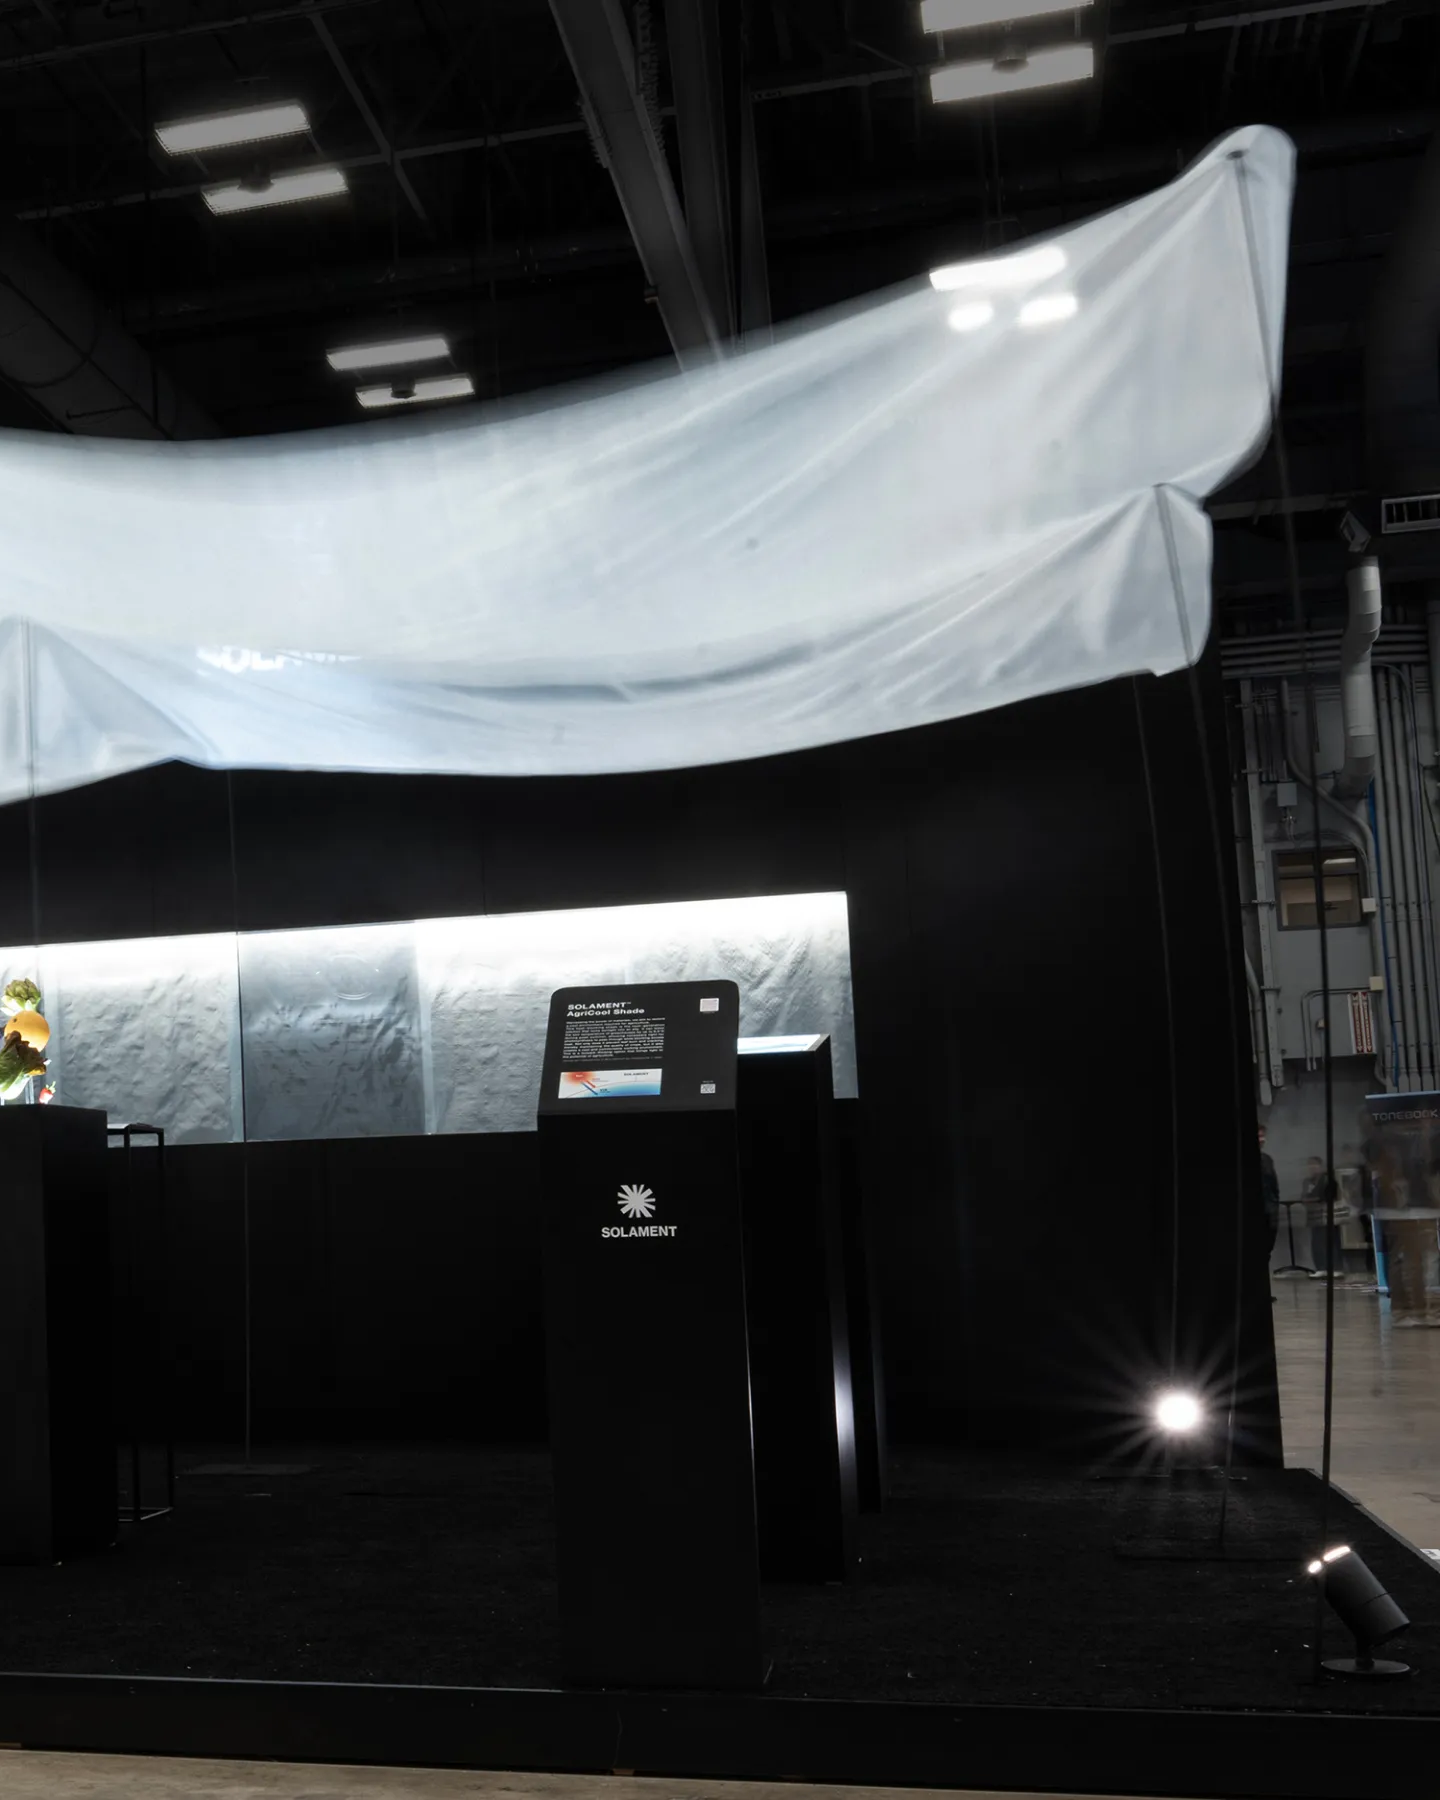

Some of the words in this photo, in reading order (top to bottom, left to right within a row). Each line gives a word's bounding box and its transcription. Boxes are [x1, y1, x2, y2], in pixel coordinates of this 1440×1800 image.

[566, 1009, 611, 1018] AgriCool
[613, 1007, 645, 1015] Shade
[1372, 1109, 1438, 1121] TONEBOOK
[601, 1225, 678, 1239] SOLAMENT
